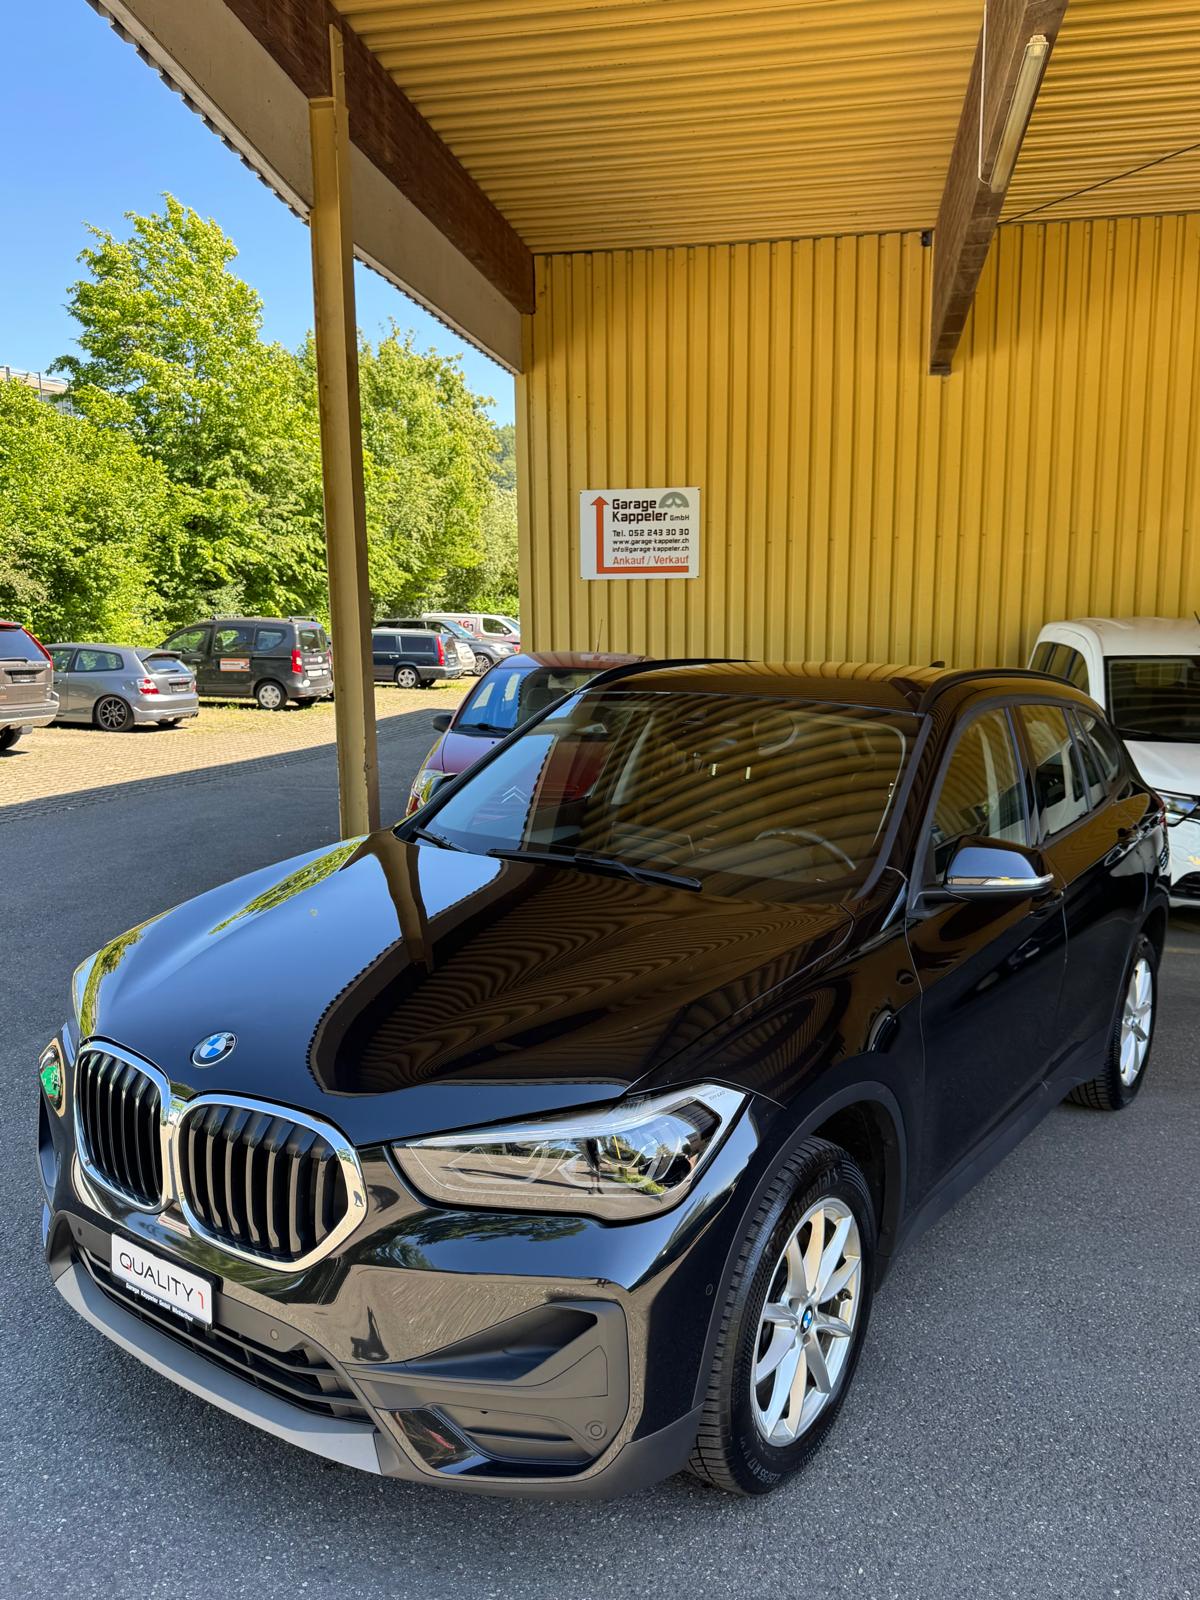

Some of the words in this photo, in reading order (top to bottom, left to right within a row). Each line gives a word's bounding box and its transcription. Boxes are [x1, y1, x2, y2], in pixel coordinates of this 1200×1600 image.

[612, 499, 657, 511] Garage
[612, 511, 668, 524] Kappeler
[612, 529, 626, 537] Tel.
[628, 529, 645, 537] 052
[666, 528, 677, 536] 30
[678, 528, 690, 536] 30
[612, 537, 690, 546] www.garage-kappeler.ch
[612, 555, 646, 565] Ankauf
[646, 555, 652, 565] /
[653, 555, 689, 564] Verkauf
[119, 1252, 194, 1302] QUALITY
[197, 1290, 205, 1310] 1
